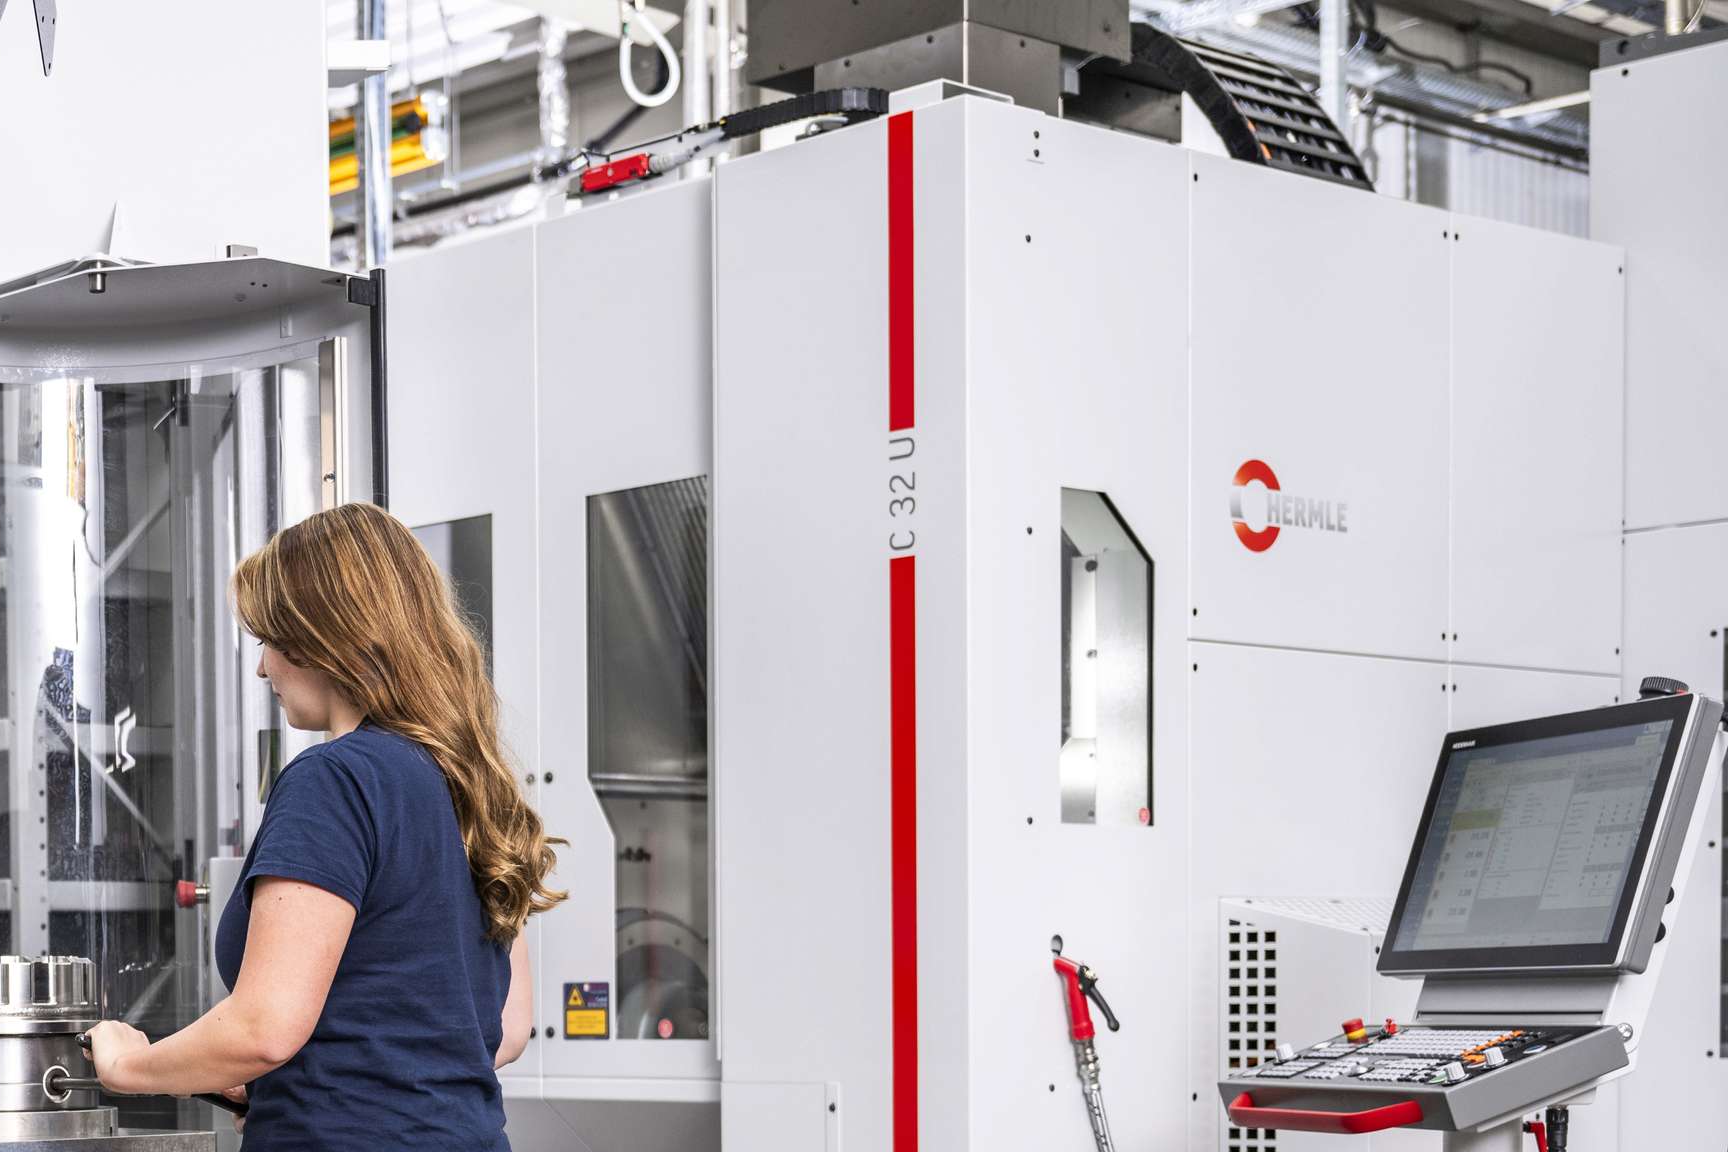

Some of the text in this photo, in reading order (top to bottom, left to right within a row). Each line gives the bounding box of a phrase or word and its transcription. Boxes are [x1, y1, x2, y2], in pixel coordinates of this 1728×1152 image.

[889, 437, 916, 551] C 32 U
[1267, 492, 1348, 533] HERMLE
